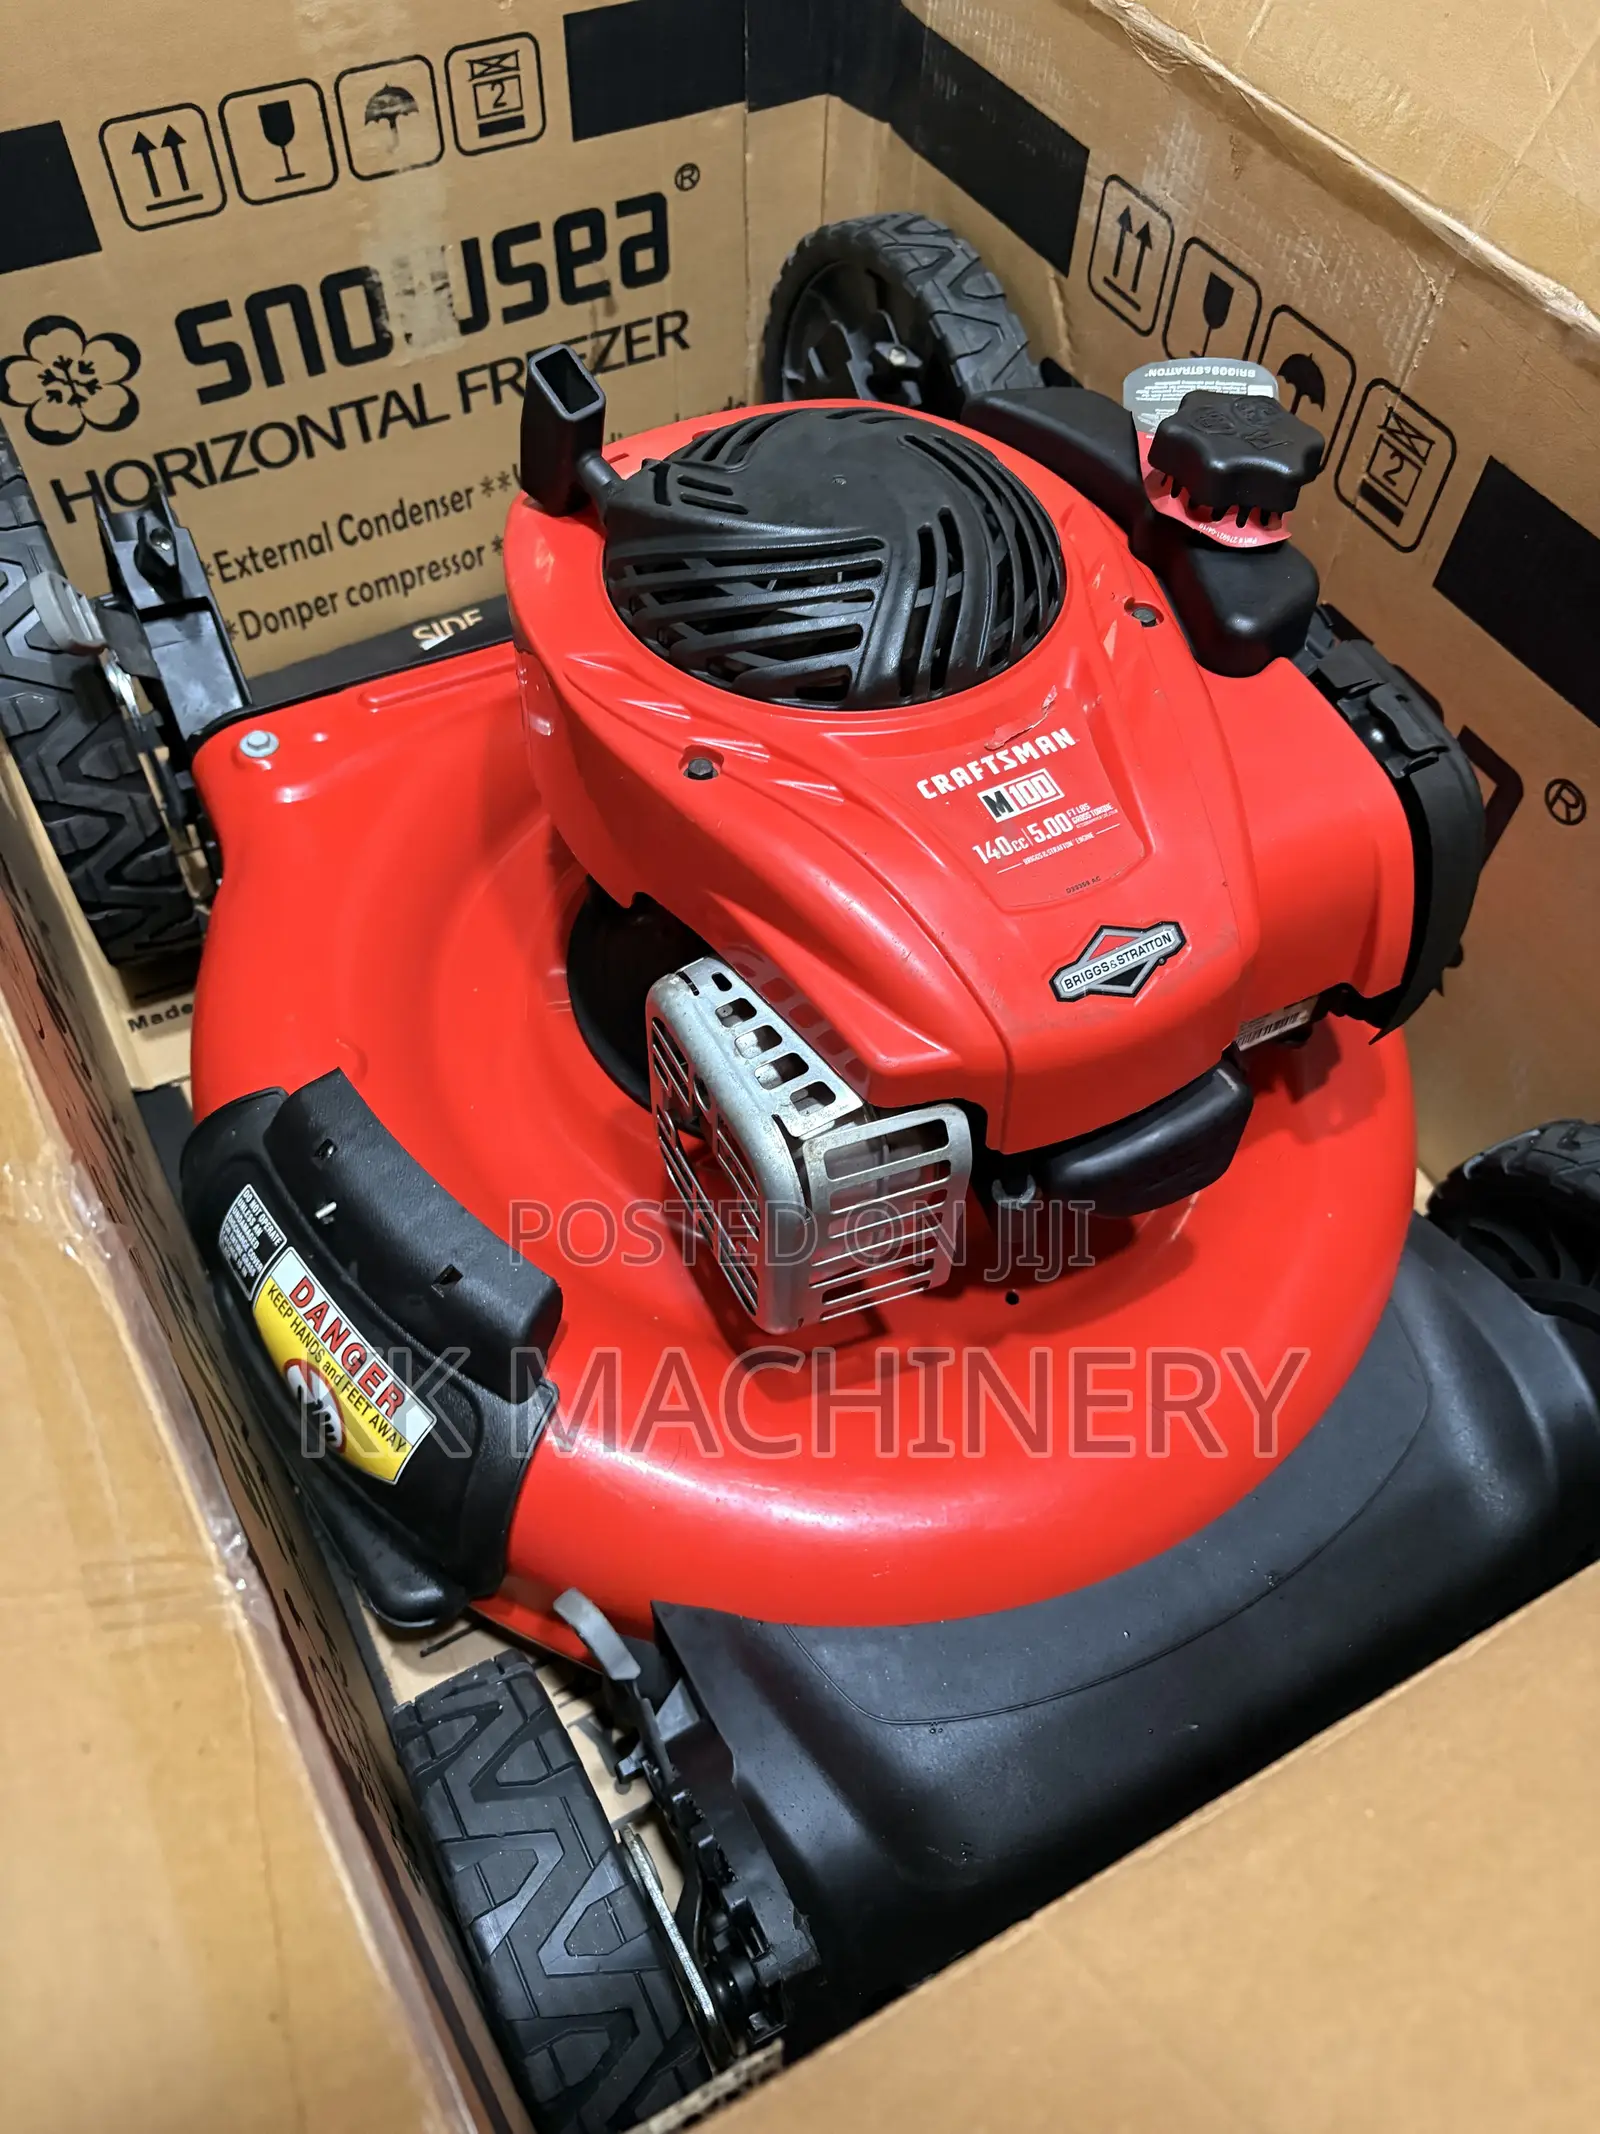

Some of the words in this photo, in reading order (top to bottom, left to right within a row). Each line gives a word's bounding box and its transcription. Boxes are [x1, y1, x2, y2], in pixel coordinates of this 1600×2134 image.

[491, 80, 507, 109] 2
[49, 382, 451, 524] HORIZONTAL
[457, 309, 691, 415] FRZER
[1382, 450, 1405, 487] 2
[337, 484, 475, 548] Condenser
[345, 545, 486, 608] compressor
[916, 727, 1076, 800] CRAFTSMAN
[982, 773, 1057, 818] M100
[127, 1001, 193, 1034] Made
[232, 1205, 260, 1250] UNDAMAGED
[237, 1197, 257, 1227] UNLESS
[252, 1223, 264, 1238] AN
[243, 1188, 253, 1203] DO
[248, 1199, 263, 1216] NOT
[258, 1213, 282, 1247] OPERATE
[267, 1284, 294, 1319] KEEP
[289, 1316, 327, 1364] HANDS
[322, 1360, 342, 1386] and
[341, 1381, 373, 1416] FEET
[368, 1413, 407, 1453] AWAY
[289, 1275, 406, 1420] DANGER
